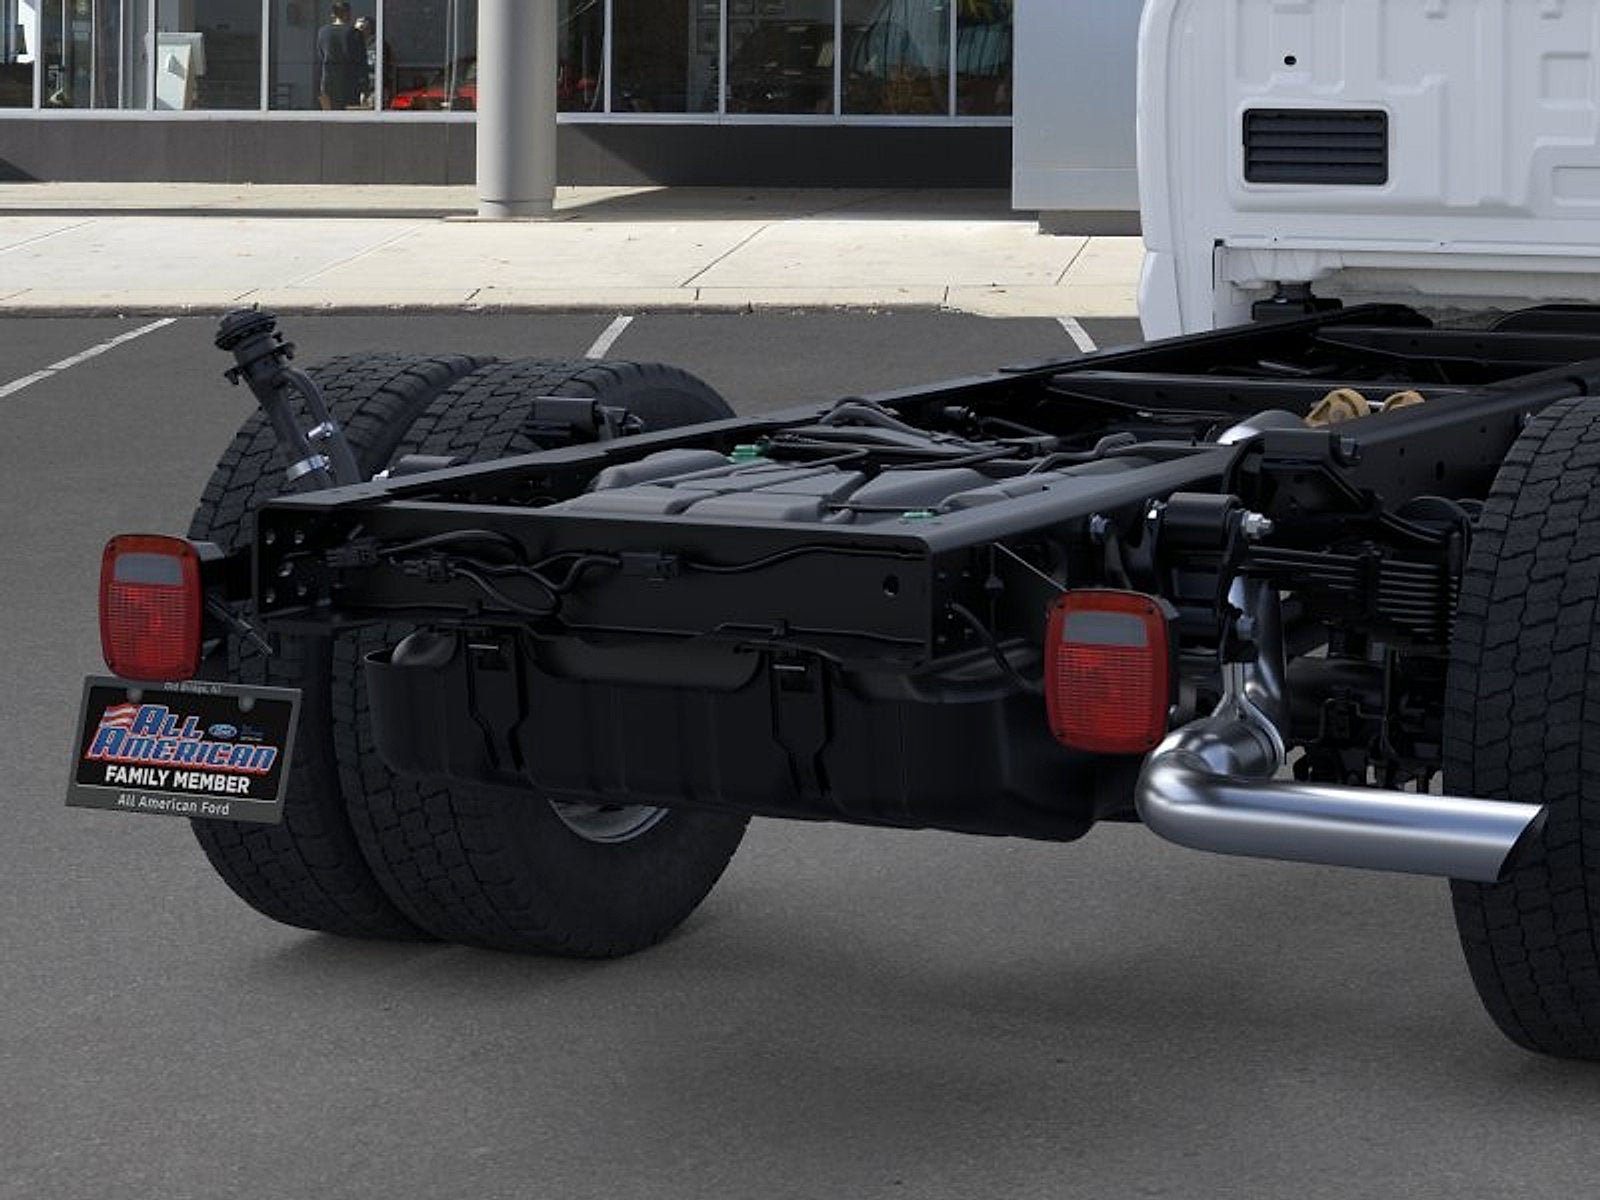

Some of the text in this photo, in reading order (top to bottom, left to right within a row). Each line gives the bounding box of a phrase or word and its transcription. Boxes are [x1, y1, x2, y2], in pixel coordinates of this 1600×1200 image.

[105, 765, 250, 794] FAMILY MEMBER
[118, 794, 229, 815] All American Ford
